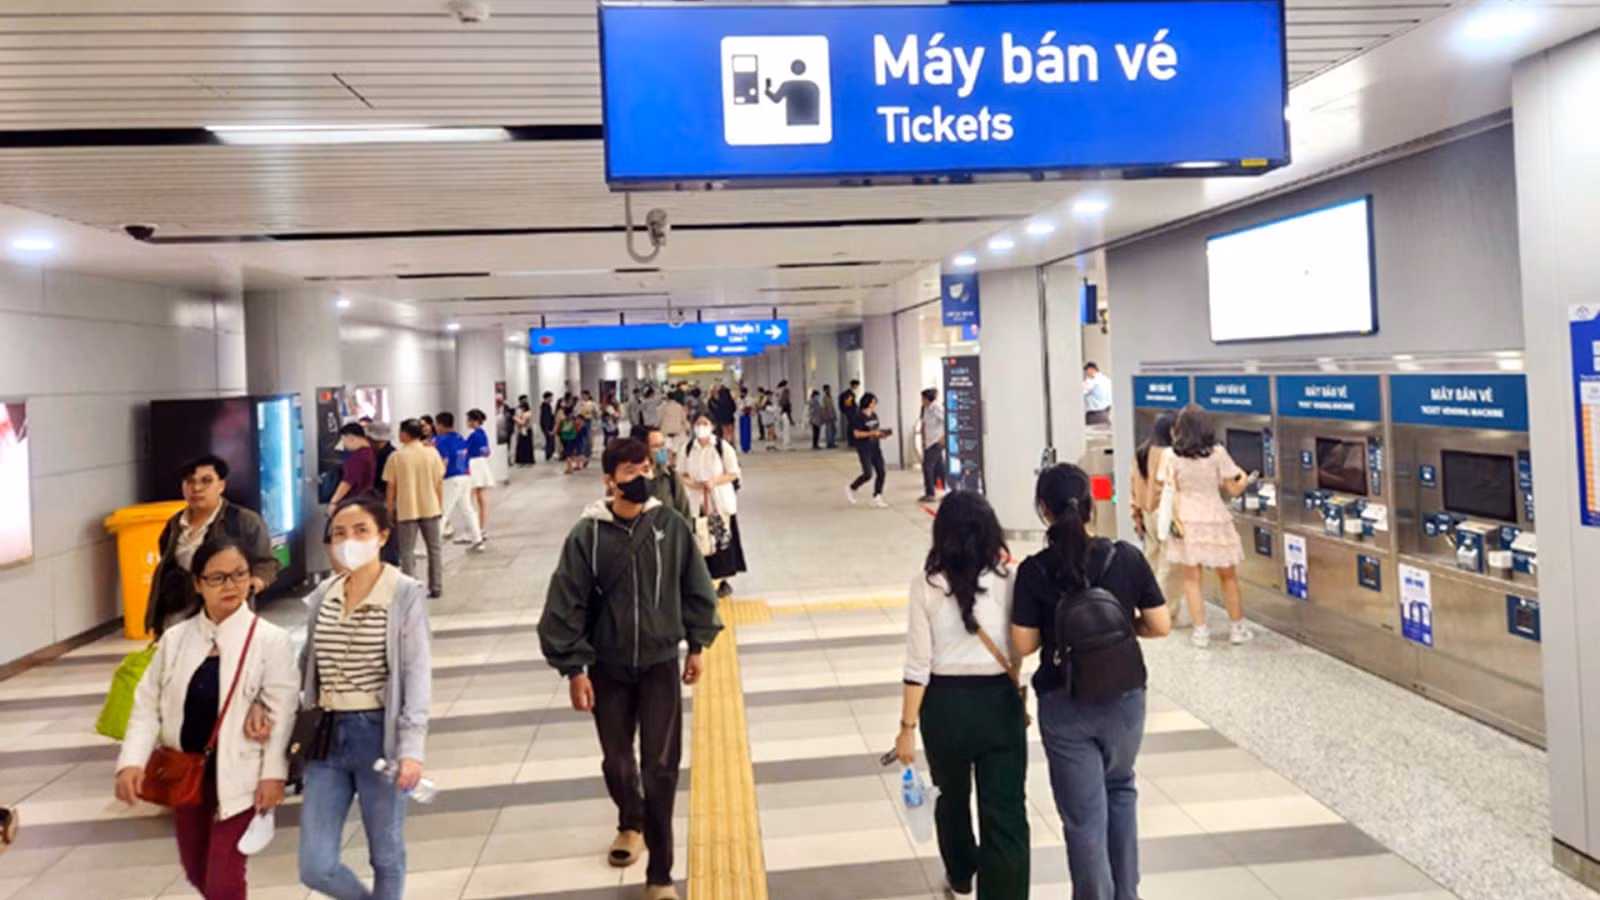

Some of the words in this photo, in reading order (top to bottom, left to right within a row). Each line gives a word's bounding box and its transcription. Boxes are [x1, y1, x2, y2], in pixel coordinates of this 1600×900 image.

[873, 32, 985, 98] Máy
[1001, 31, 1098, 83] bán
[1114, 29, 1178, 81] vé
[877, 106, 1014, 143] Tickets
[1431, 386, 1454, 401] MÁY
[1455, 386, 1477, 401] BÁN
